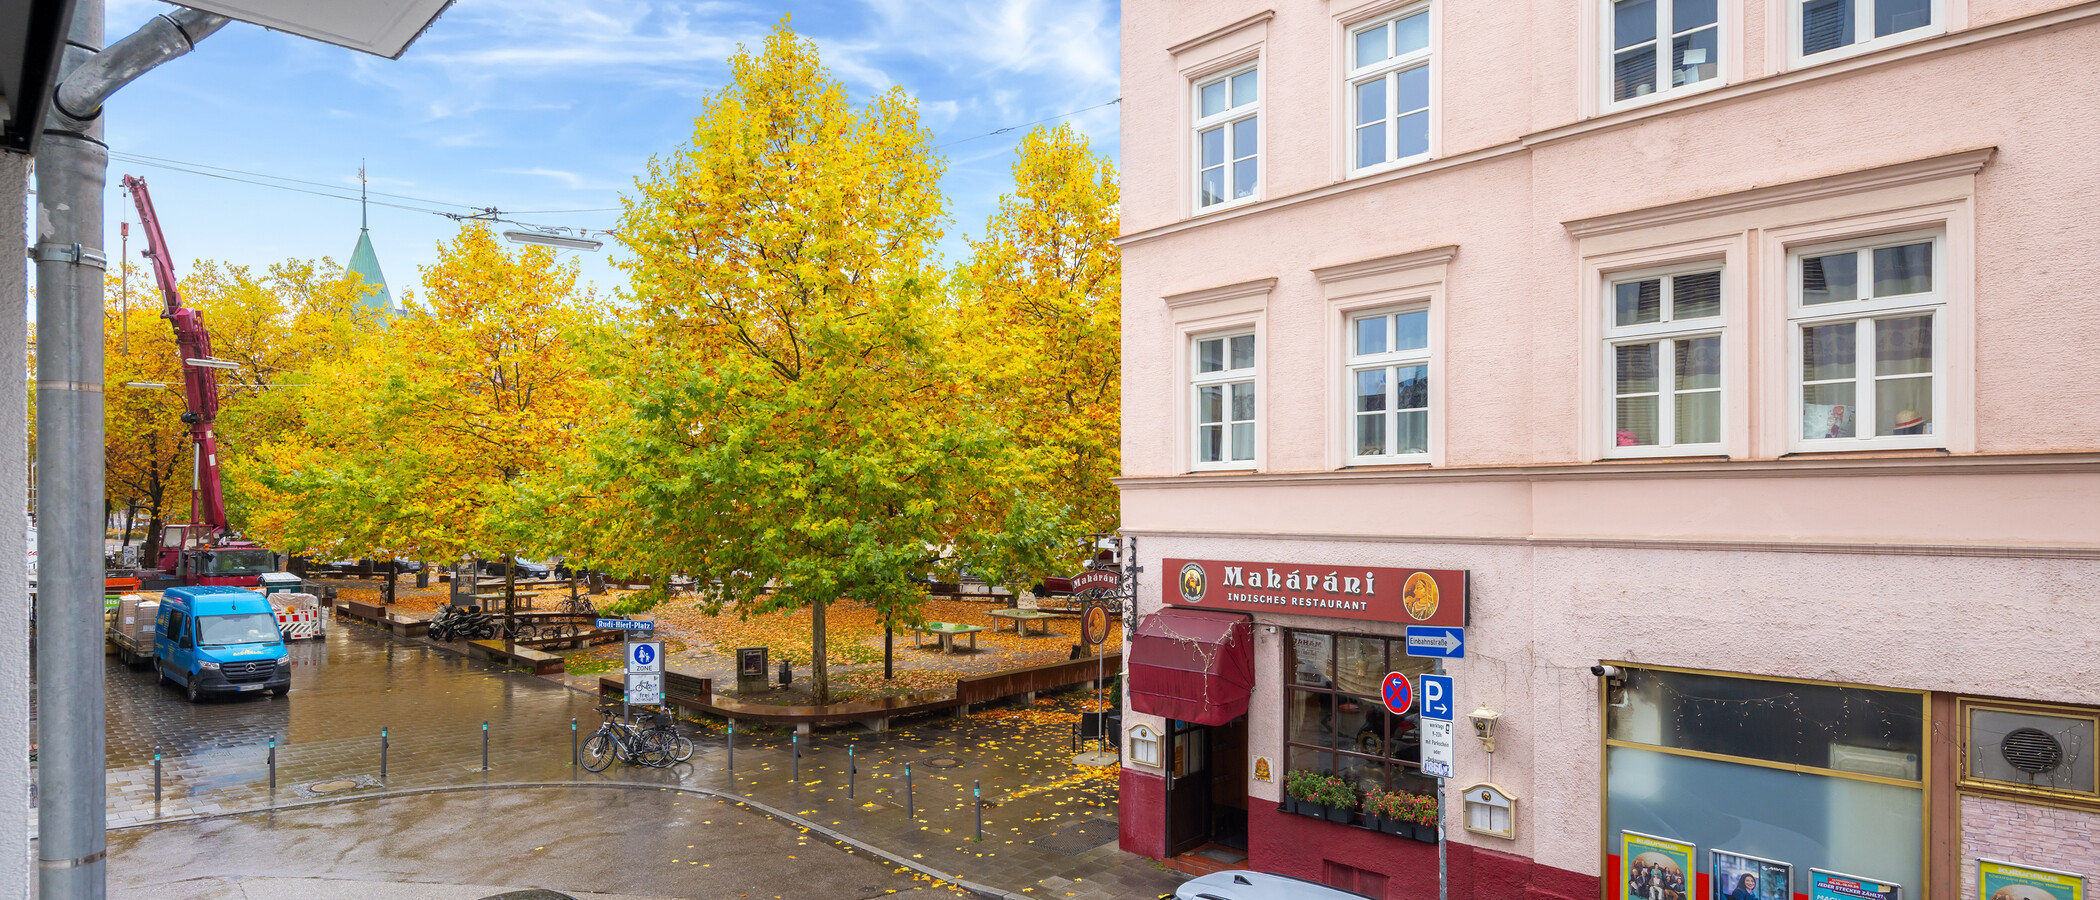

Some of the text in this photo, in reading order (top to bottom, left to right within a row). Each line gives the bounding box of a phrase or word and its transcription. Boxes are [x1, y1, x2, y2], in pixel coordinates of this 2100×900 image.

[1228, 593, 1368, 611] INDISCHES RESTAURANT
[1409, 637, 1448, 647] Einbahnstraße
[1425, 680, 1444, 713] P
[1817, 881, 1835, 890] JEDER
[1835, 885, 1861, 895] STECKER
